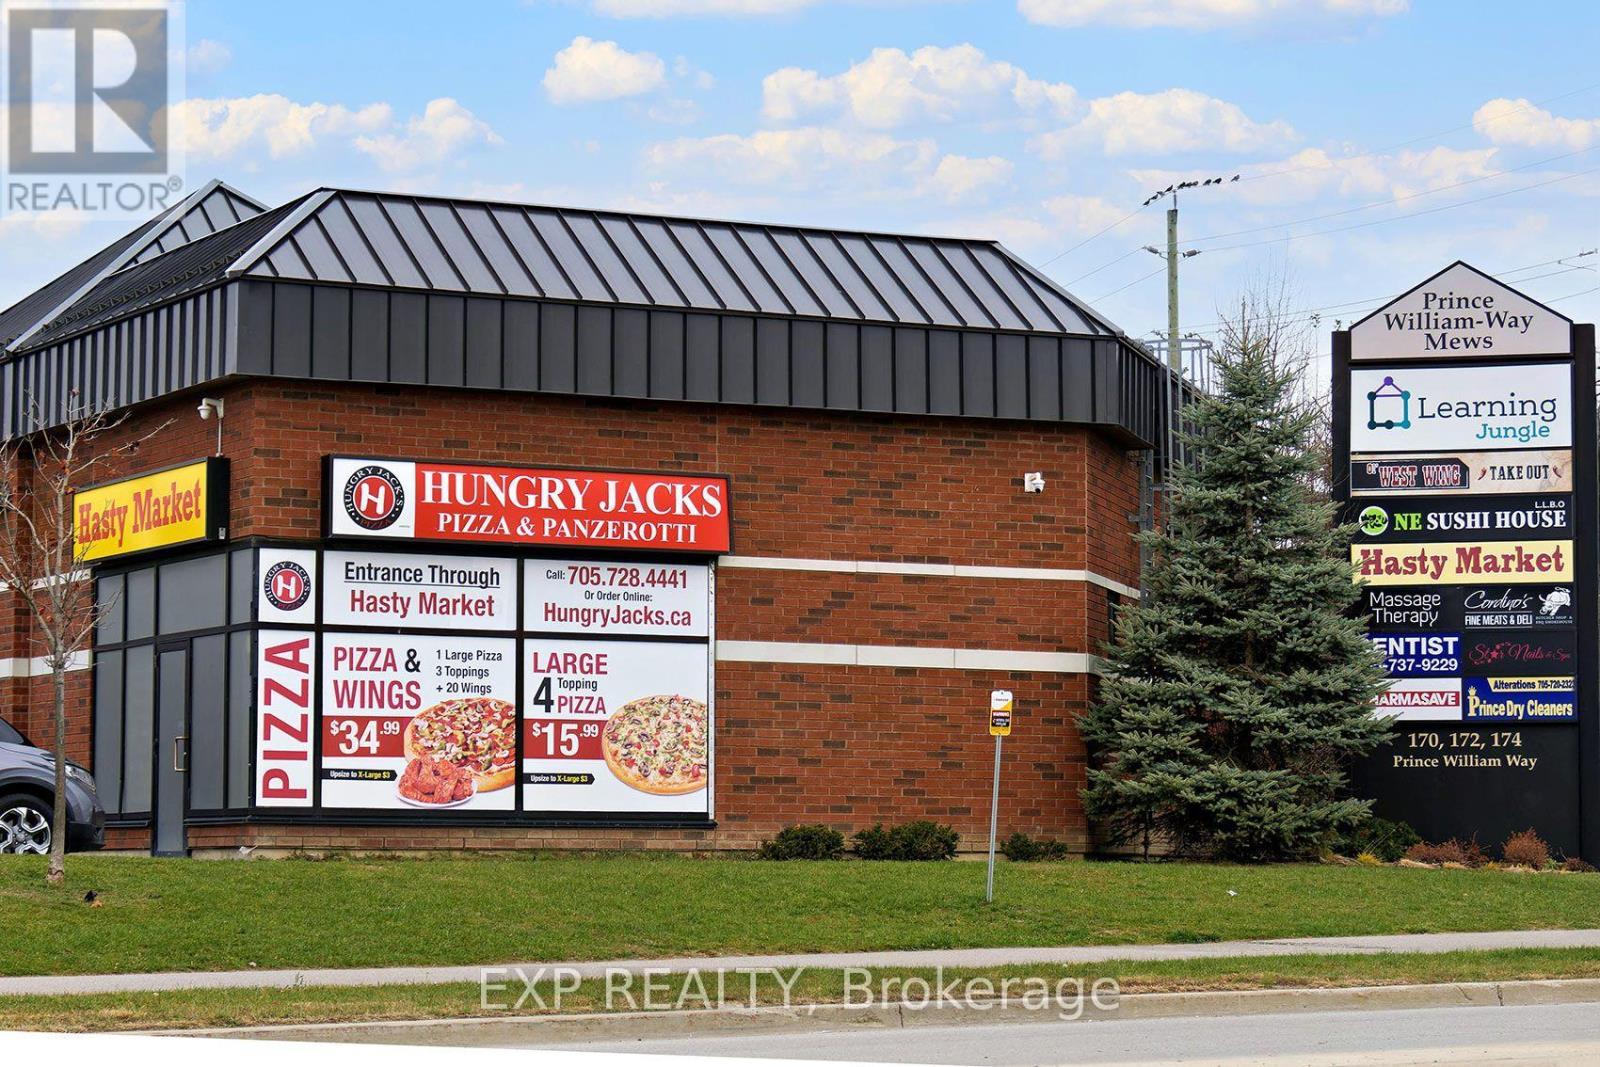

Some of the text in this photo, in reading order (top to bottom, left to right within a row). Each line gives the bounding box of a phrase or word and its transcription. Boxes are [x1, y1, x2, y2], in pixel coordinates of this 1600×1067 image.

[1422, 292, 1494, 310] Prince
[1384, 310, 1534, 334] William-Way
[1424, 332, 1493, 350] Mews
[1418, 392, 1557, 422] Learning
[1476, 420, 1550, 442] Jungle
[1379, 464, 1461, 487] WEST WING
[1490, 464, 1550, 481] TAKE OUT
[344, 467, 373, 513] HUNGRY
[360, 482, 386, 515] H
[421, 470, 722, 518] HUNGRY JACKS
[78, 479, 202, 548] Hasty Market
[1426, 511, 1490, 530] SUSHI
[1495, 510, 1566, 529] HOUSE
[437, 513, 697, 544] PIZZA & PANZEROTTI
[1360, 545, 1565, 580] Hasty Market
[344, 561, 500, 589] Entrance Through
[545, 566, 688, 589] Call: 705.728.4441
[277, 574, 296, 600] H
[584, 590, 653, 602] Or Order Online:
[350, 589, 495, 618] Hasty Market
[1369, 591, 1441, 611] Massage
[543, 602, 692, 628] HungryJacks.ca
[1372, 608, 1439, 627] Therapy
[1464, 614, 1533, 626] FINE MEATS & DELI
[436, 650, 503, 663] 1 Large Pizza
[1366, 637, 1459, 655] ENTIST
[1508, 643, 1544, 662] Nails
[333, 646, 421, 673] PIZZA &
[532, 652, 608, 675] LARGE
[1370, 658, 1458, 671] -737-9229
[435, 666, 490, 680] 3 Toppings
[333, 679, 422, 710] WINGS
[435, 683, 492, 696] + 20 Wings
[533, 677, 598, 713] 4 Topping
[1493, 680, 1536, 690] Alterations
[557, 695, 606, 715] PIZZA
[1370, 692, 1456, 706] ARMASAVE
[1468, 695, 1573, 720] Prince Dry Cleaners
[262, 637, 310, 799] PIZZA
[330, 720, 400, 755] $34.99
[532, 722, 599, 757] $15.99
[1408, 732, 1522, 750] 170, 172, 174
[1393, 754, 1537, 771] Prince William Way
[329, 770, 350, 778] Upsize
[530, 774, 588, 783] Upsize to X-Large $3
